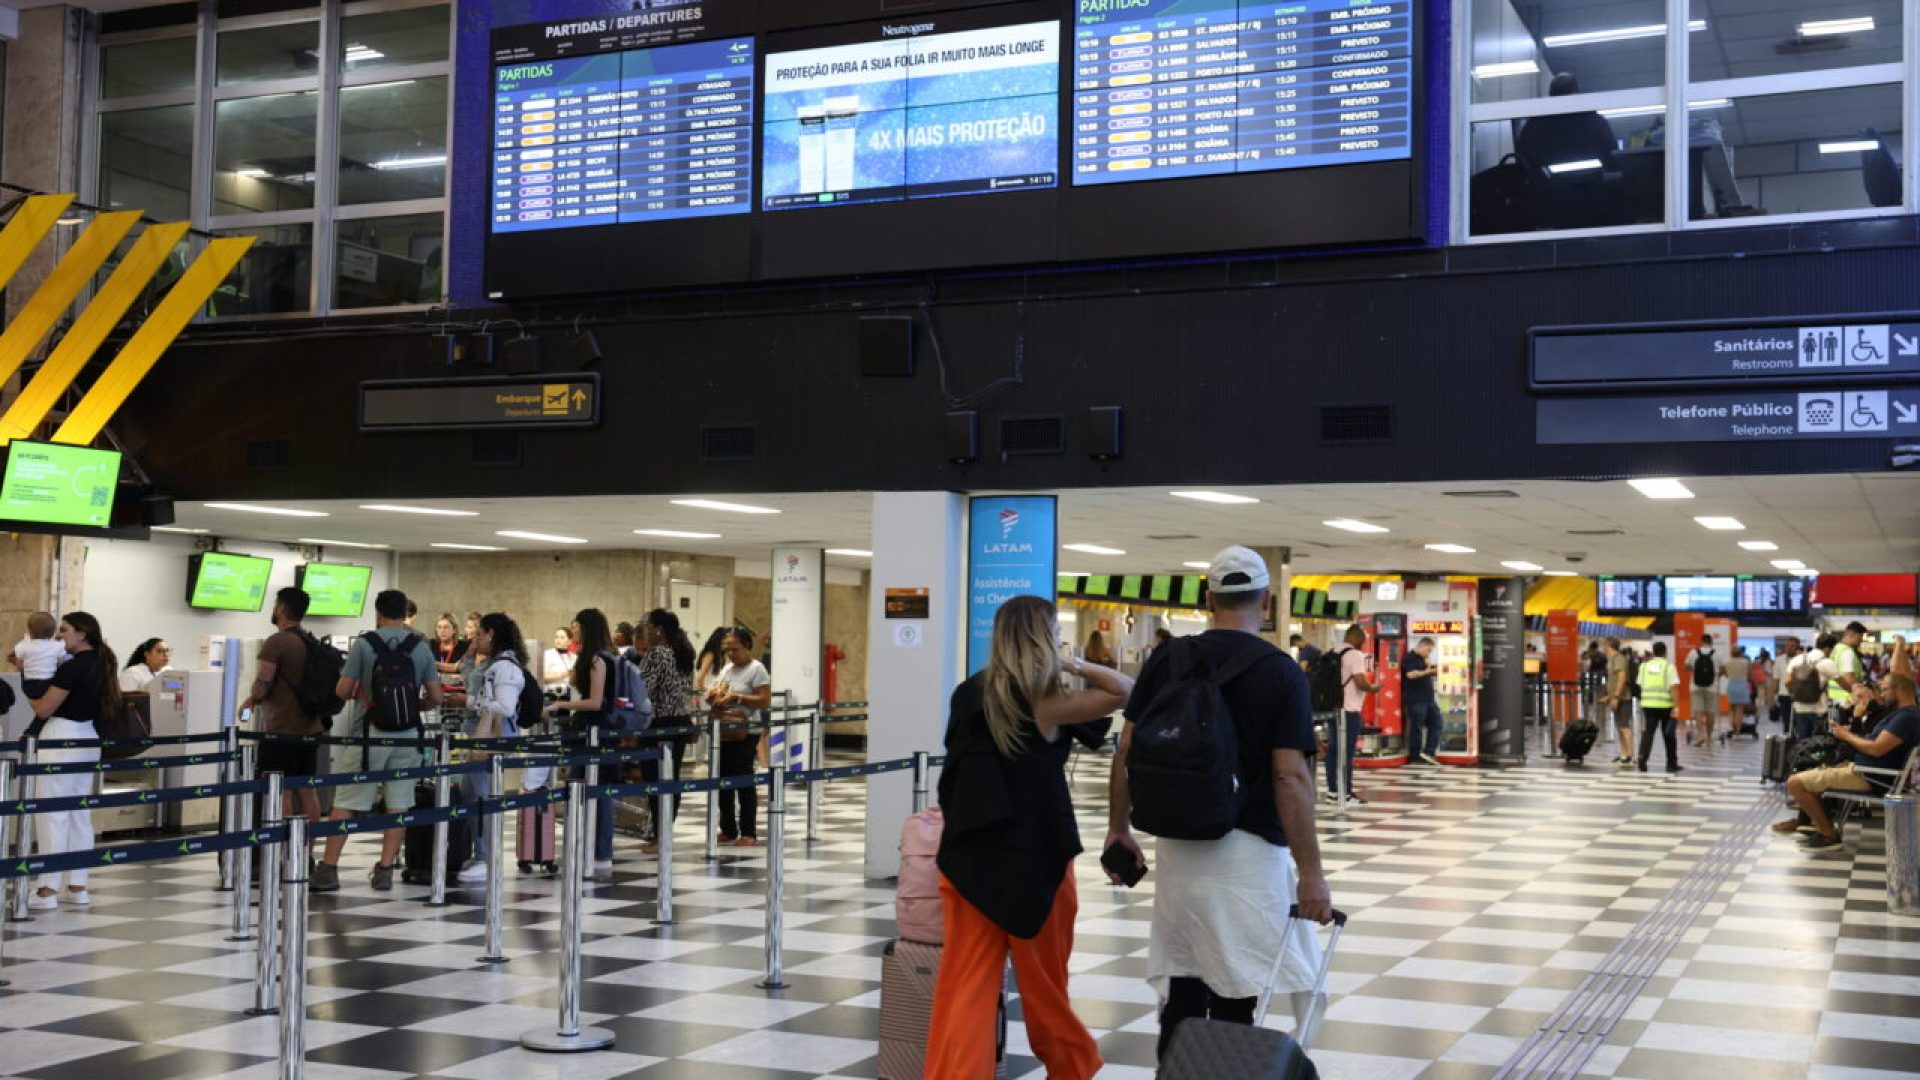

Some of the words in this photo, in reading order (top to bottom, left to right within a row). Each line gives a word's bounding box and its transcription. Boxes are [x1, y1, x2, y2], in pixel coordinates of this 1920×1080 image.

[1353, 5, 1391, 17] PRÓXIMO
[545, 20, 606, 38] PARTIDAS
[617, 7, 703, 30] DEPARTURES
[1353, 20, 1391, 32] PRÓXIMO
[882, 22, 935, 36] Neutrogena
[1341, 36, 1380, 48] PREVISTO
[777, 63, 829, 81] PROTEÇÃO
[831, 60, 859, 75] PARA
[861, 58, 868, 71] A
[871, 56, 892, 71] SUA
[894, 52, 925, 68] FOLIA
[928, 51, 939, 64] IR
[941, 47, 976, 63] MUITO
[978, 44, 1006, 59] MAIS
[1009, 39, 1045, 56] LONGE
[1332, 51, 1388, 63] CONFIRMADO
[499, 64, 553, 82] PARTIDAS
[1332, 66, 1388, 78] CONFIRMADO
[697, 80, 732, 91] ATRASADO
[1352, 80, 1390, 92] PRÓXIMO
[693, 92, 736, 104] CONFIRMADO
[1341, 96, 1379, 108] PREVISTO
[1341, 111, 1379, 122] PREVISTO
[869, 129, 891, 151] 4X
[897, 123, 944, 148] MAIS
[950, 112, 1046, 144] PROTEÇÃO
[1341, 125, 1379, 137] PREVISTO
[1341, 140, 1379, 151] PREVISTO
[1714, 336, 1795, 353] Sanitários
[1732, 358, 1795, 371] Restrooms
[1658, 404, 1728, 420] Telefone
[1731, 401, 1794, 418] Público
[1731, 423, 1794, 437] Telephone
[984, 543, 1032, 553] LATAM
[975, 574, 1031, 589] Assistência
